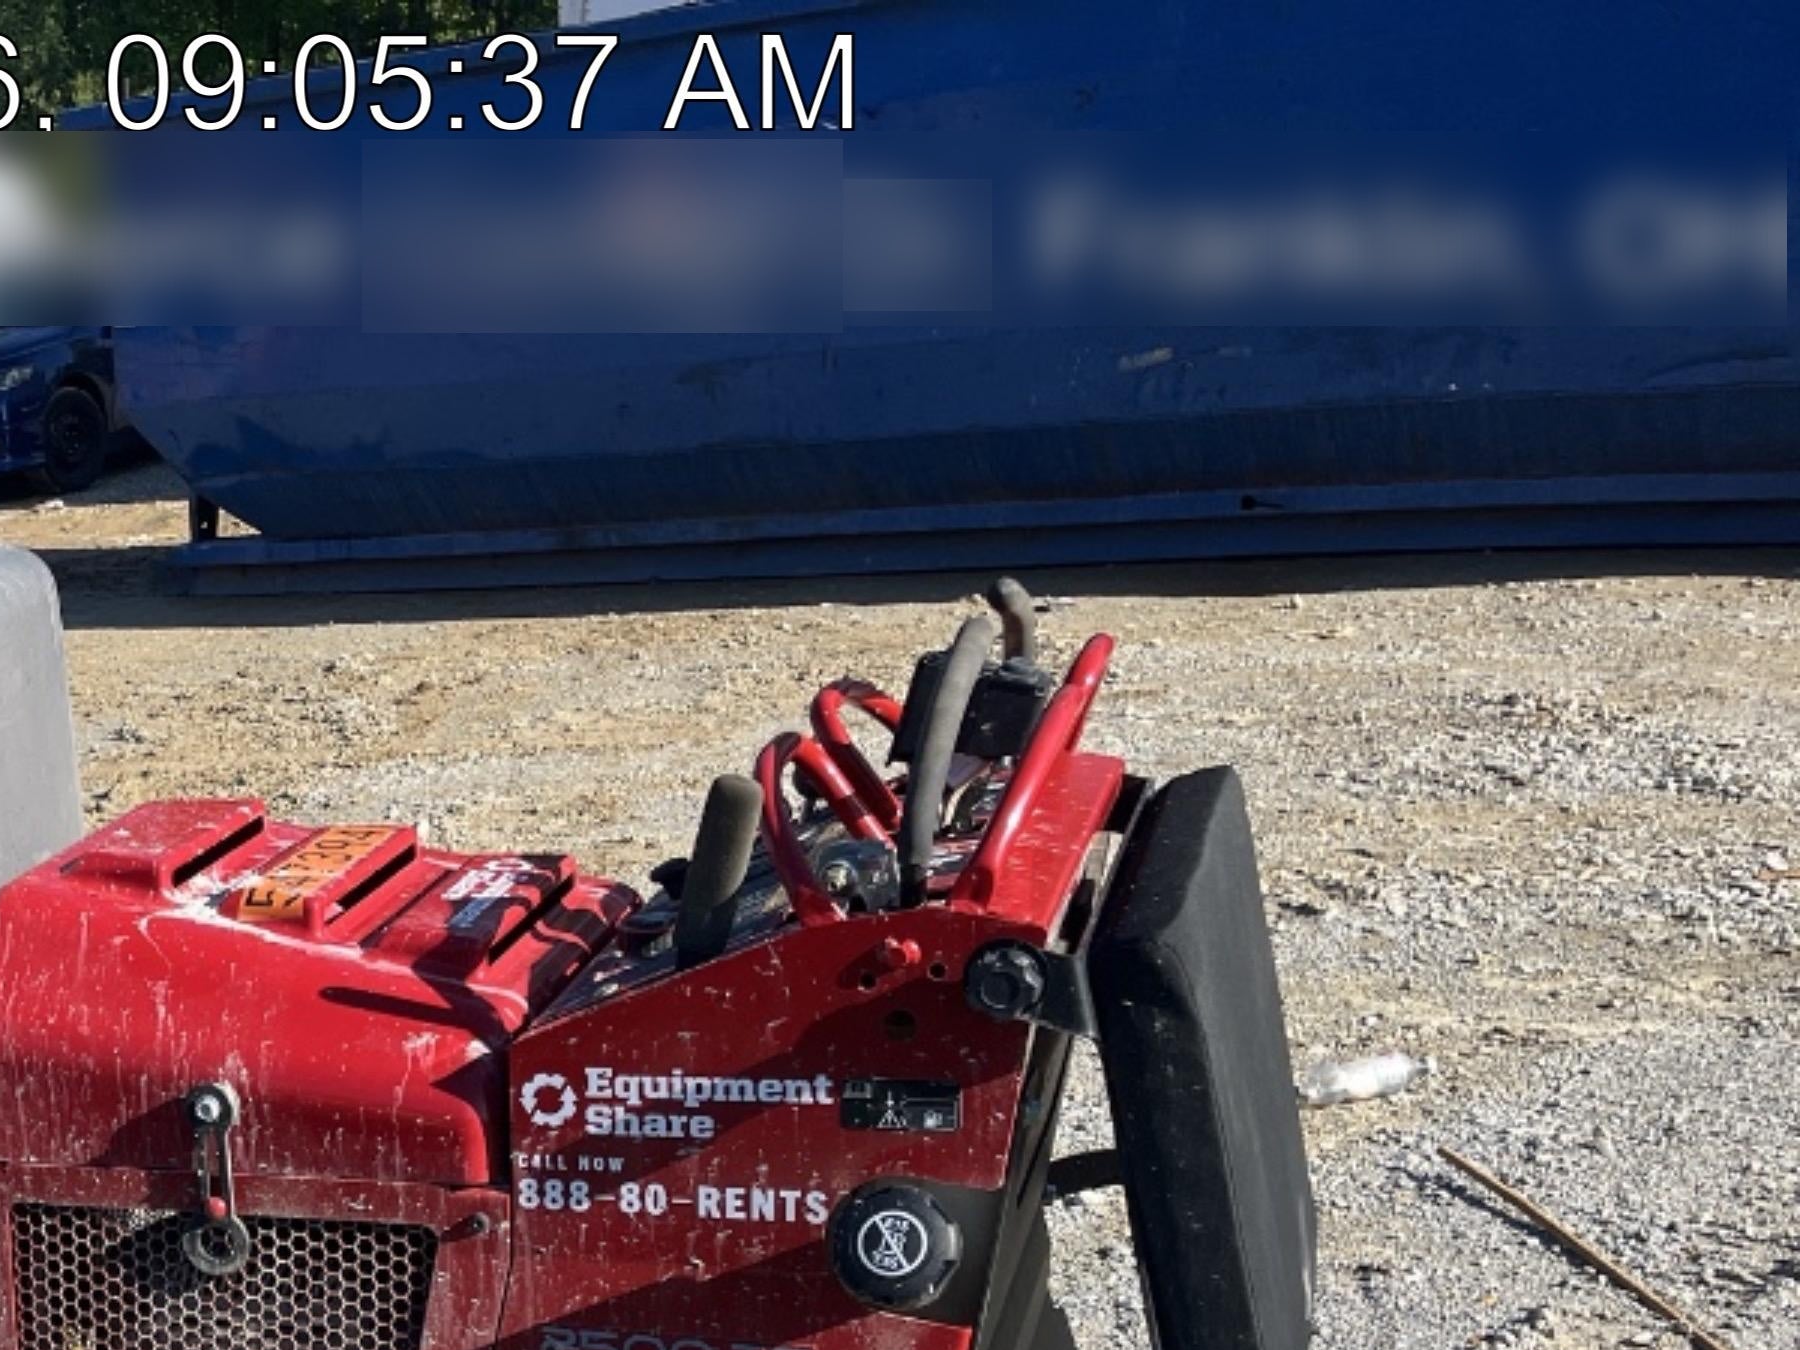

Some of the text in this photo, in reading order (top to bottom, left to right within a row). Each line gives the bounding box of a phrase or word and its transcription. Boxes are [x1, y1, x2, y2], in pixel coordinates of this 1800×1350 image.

[584, 1066, 835, 1108] Equipment
[584, 1102, 715, 1139] Share
[517, 1153, 625, 1172] CALL NOW
[517, 1177, 830, 1226] 888-80-RENTS
